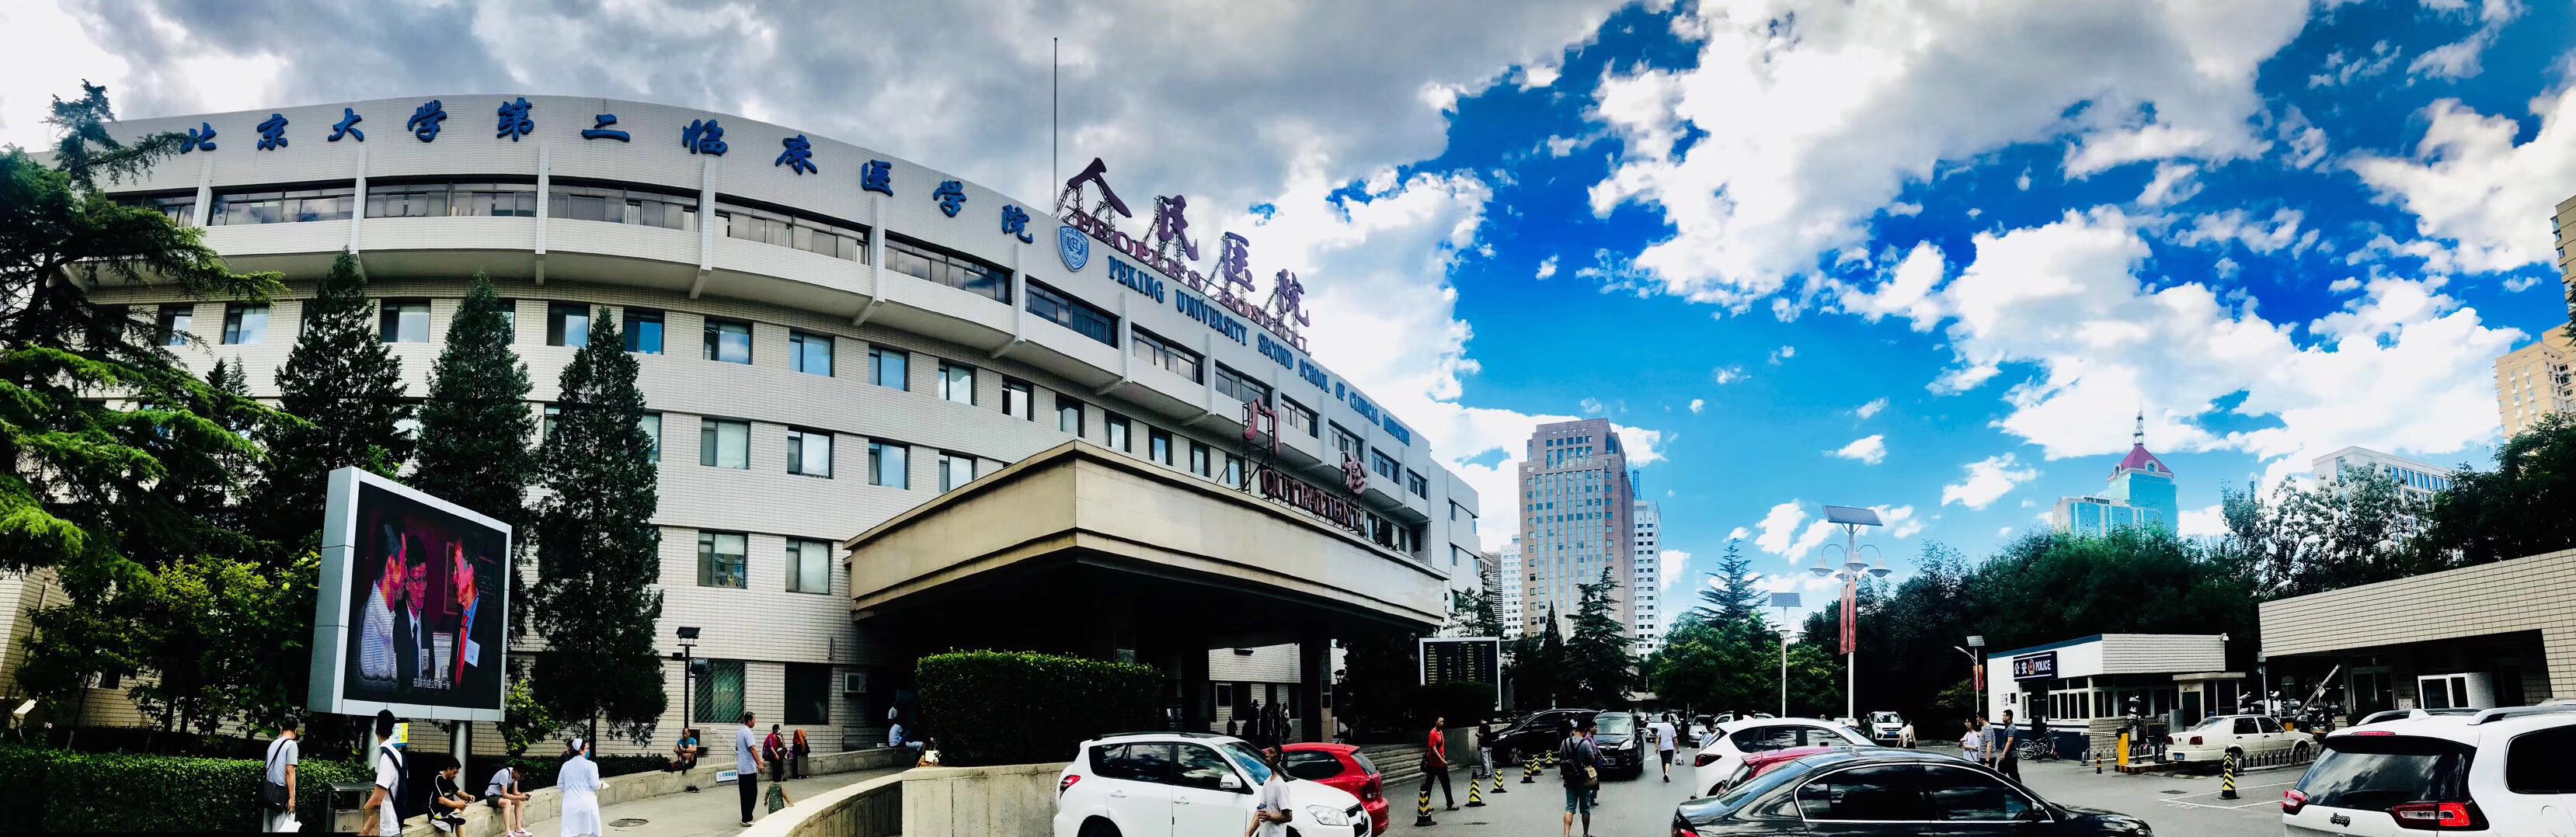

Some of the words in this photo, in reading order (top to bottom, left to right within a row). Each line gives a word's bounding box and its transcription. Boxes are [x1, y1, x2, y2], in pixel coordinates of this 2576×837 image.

[1077, 210, 1202, 290] PEOPLE'S
[1218, 287, 1311, 356] HOSPITAL
[1108, 255, 1164, 304] PEKING
[1175, 289, 1248, 346] UNIVERSITY
[1258, 332, 1293, 370] SECOND
[1299, 358, 1330, 394] SCHOOL
[1335, 380, 1345, 401] OF
[1349, 391, 1380, 426] CLINICAL
[2014, 662, 2028, 675] 公安
[2035, 660, 2051, 672] POLICE
[2331, 812, 2351, 827] Jeep
